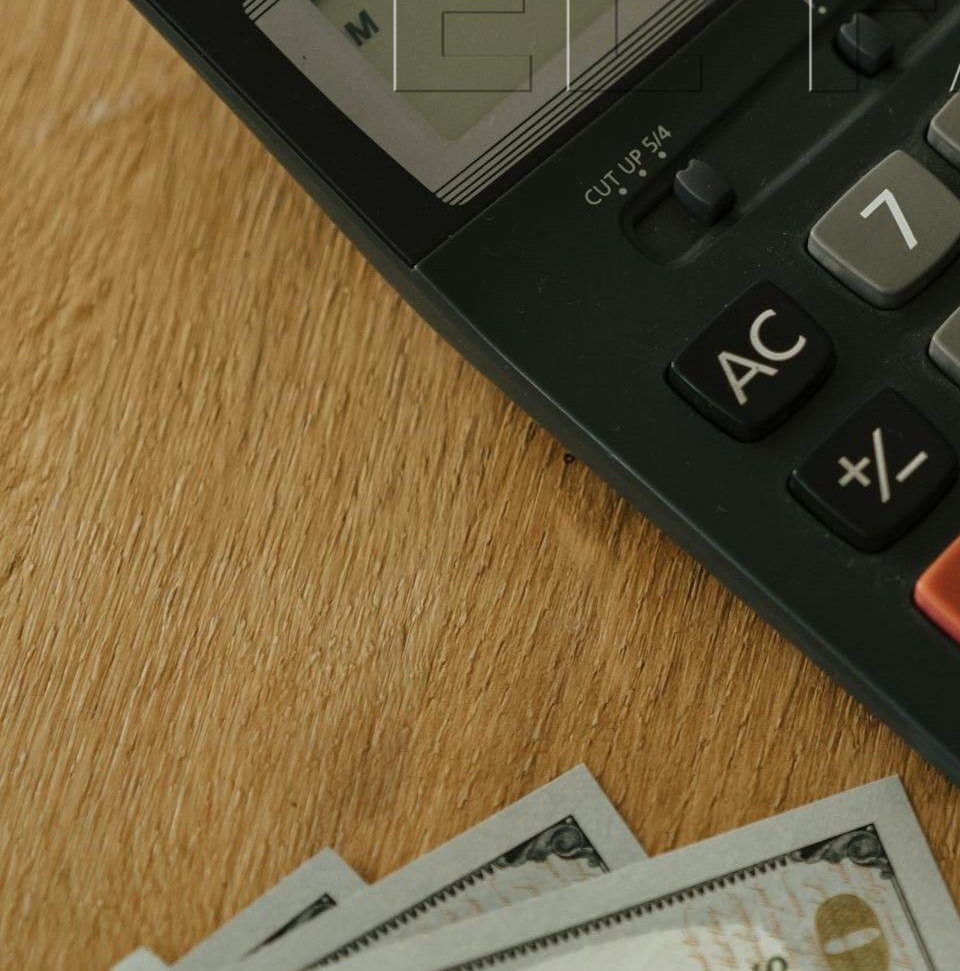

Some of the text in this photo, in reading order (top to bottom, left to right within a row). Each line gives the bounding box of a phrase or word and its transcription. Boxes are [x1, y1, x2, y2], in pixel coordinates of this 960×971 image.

[344, 9, 380, 47] M
[584, 125, 672, 205] CUT UP 5/4
[859, 188, 918, 250] 7
[717, 308, 807, 406] AC
